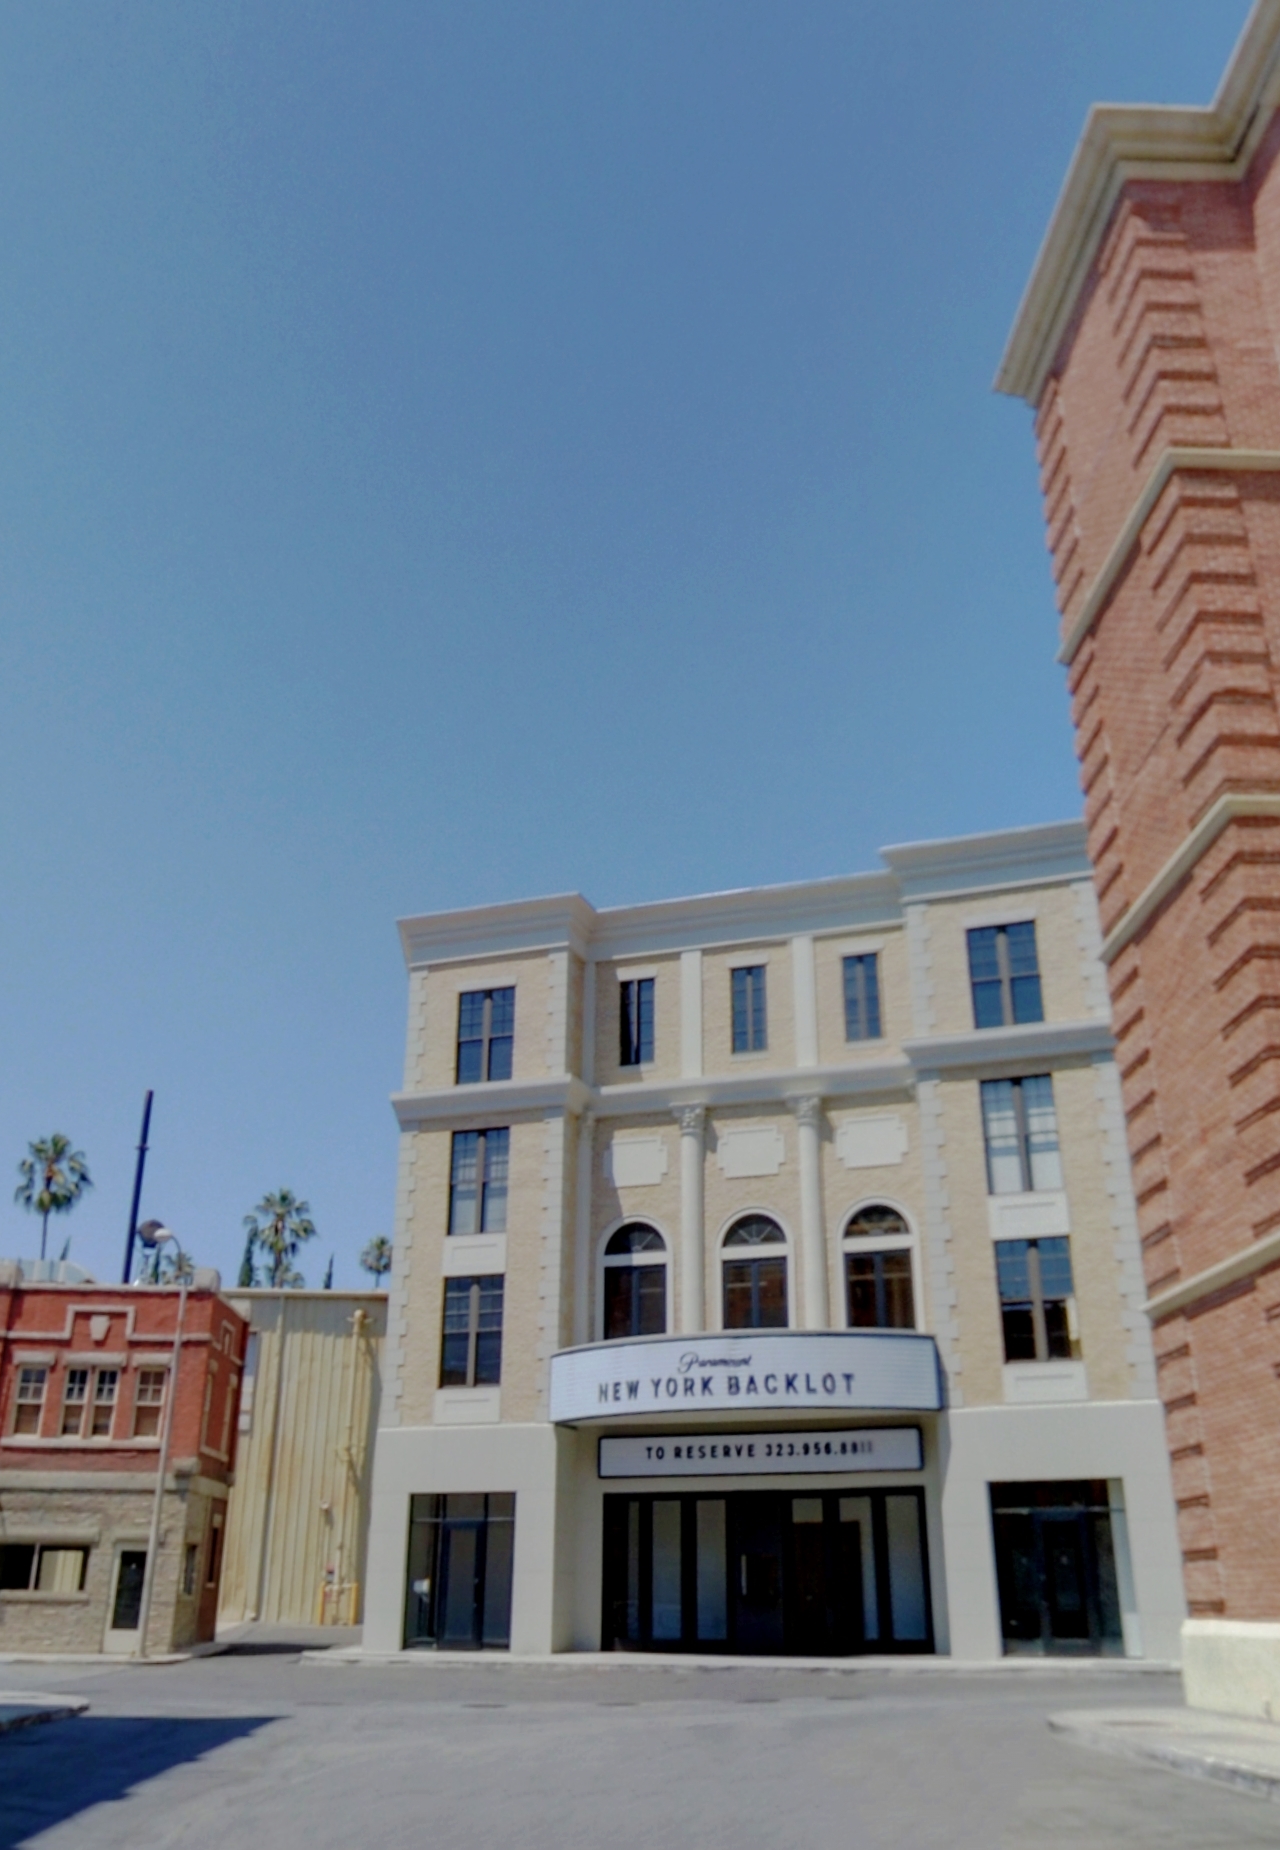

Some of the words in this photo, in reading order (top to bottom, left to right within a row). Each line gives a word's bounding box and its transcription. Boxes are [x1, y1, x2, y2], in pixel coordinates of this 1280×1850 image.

[677, 1352, 753, 1374] Paramount
[598, 1379, 640, 1403] NEW
[650, 1375, 714, 1399] YORK
[727, 1372, 856, 1396] BACKLOT
[646, 1446, 665, 1460] TO
[674, 1443, 756, 1458] RESERVE
